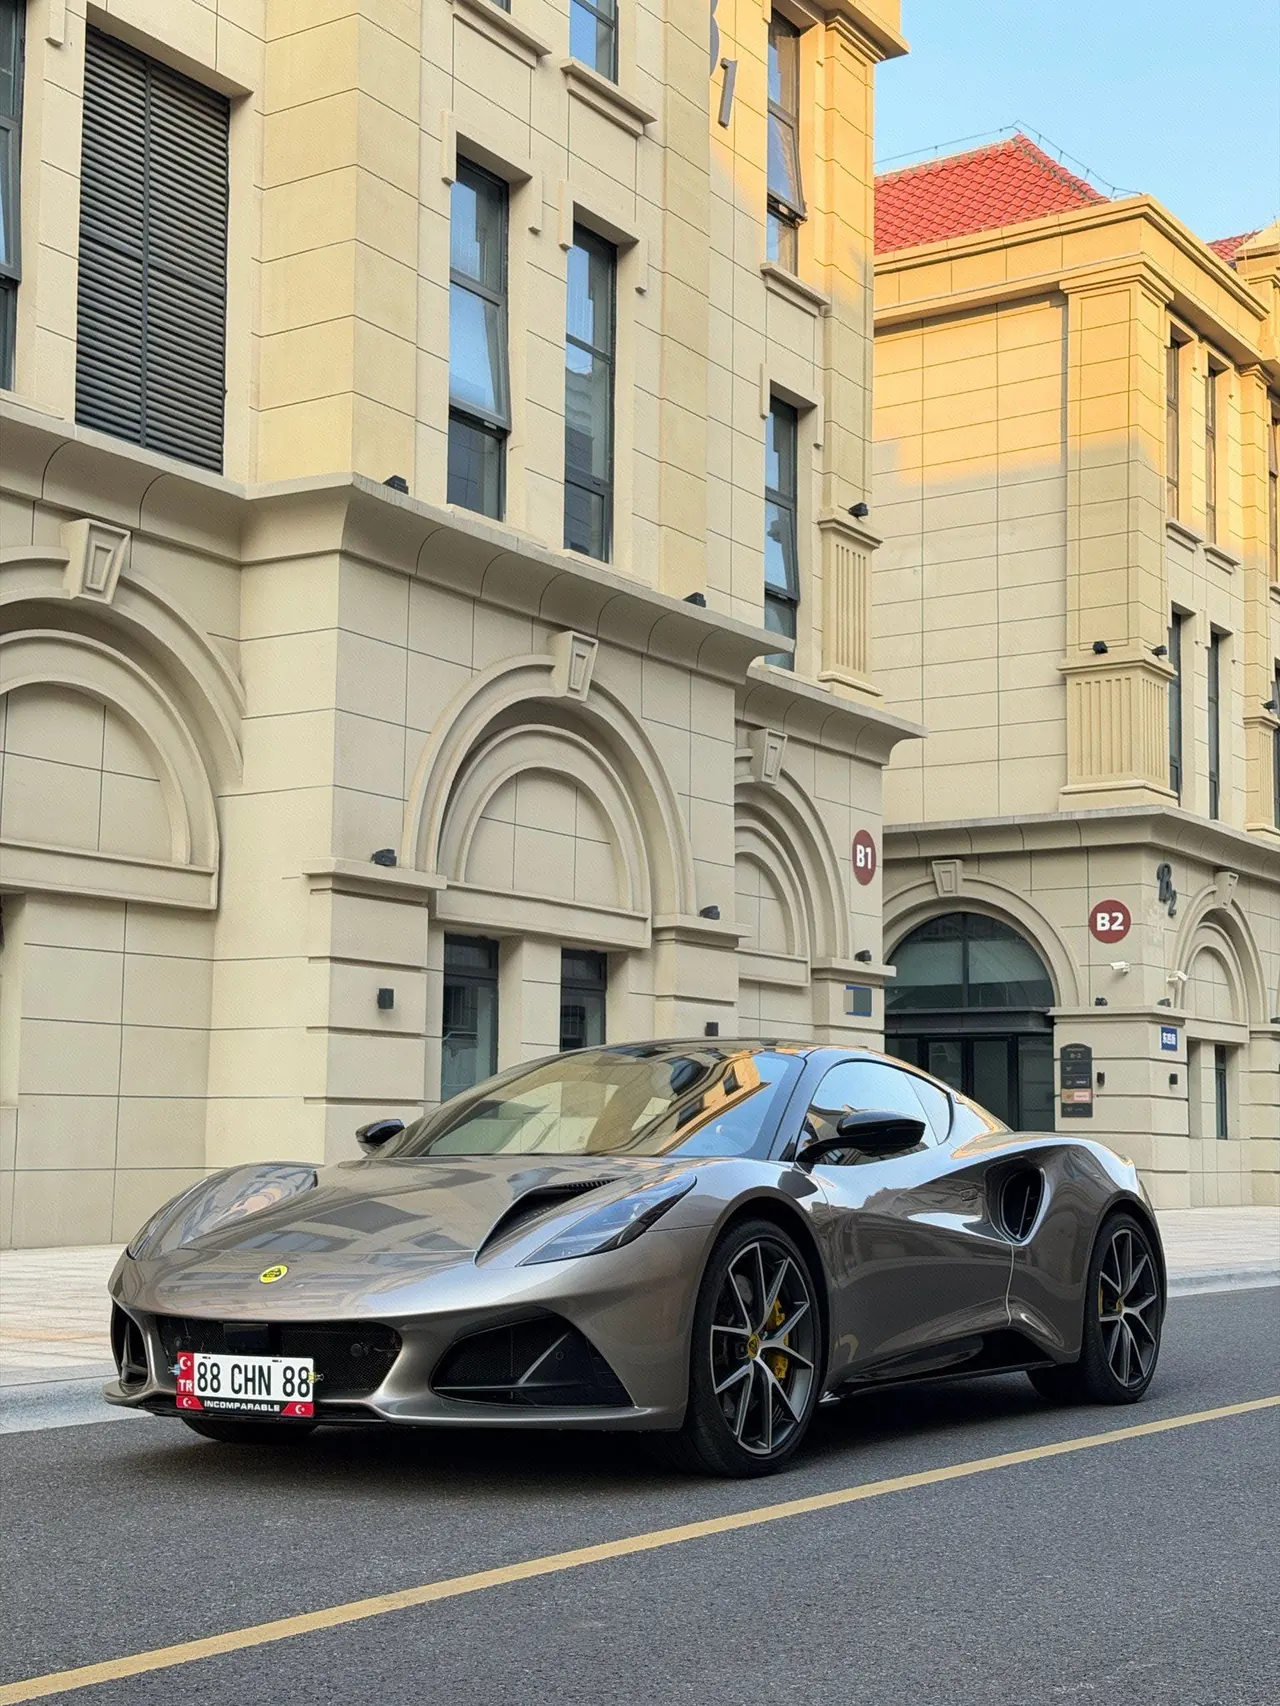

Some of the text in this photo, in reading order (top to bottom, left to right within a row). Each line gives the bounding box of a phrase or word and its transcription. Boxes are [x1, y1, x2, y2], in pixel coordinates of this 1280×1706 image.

[856, 844, 872, 870] B1
[1096, 912, 1124, 931] B2
[178, 1379, 193, 1392] TR
[197, 1362, 310, 1398] 88 CHN 88
[204, 1400, 280, 1412] INCOMPARABLE
